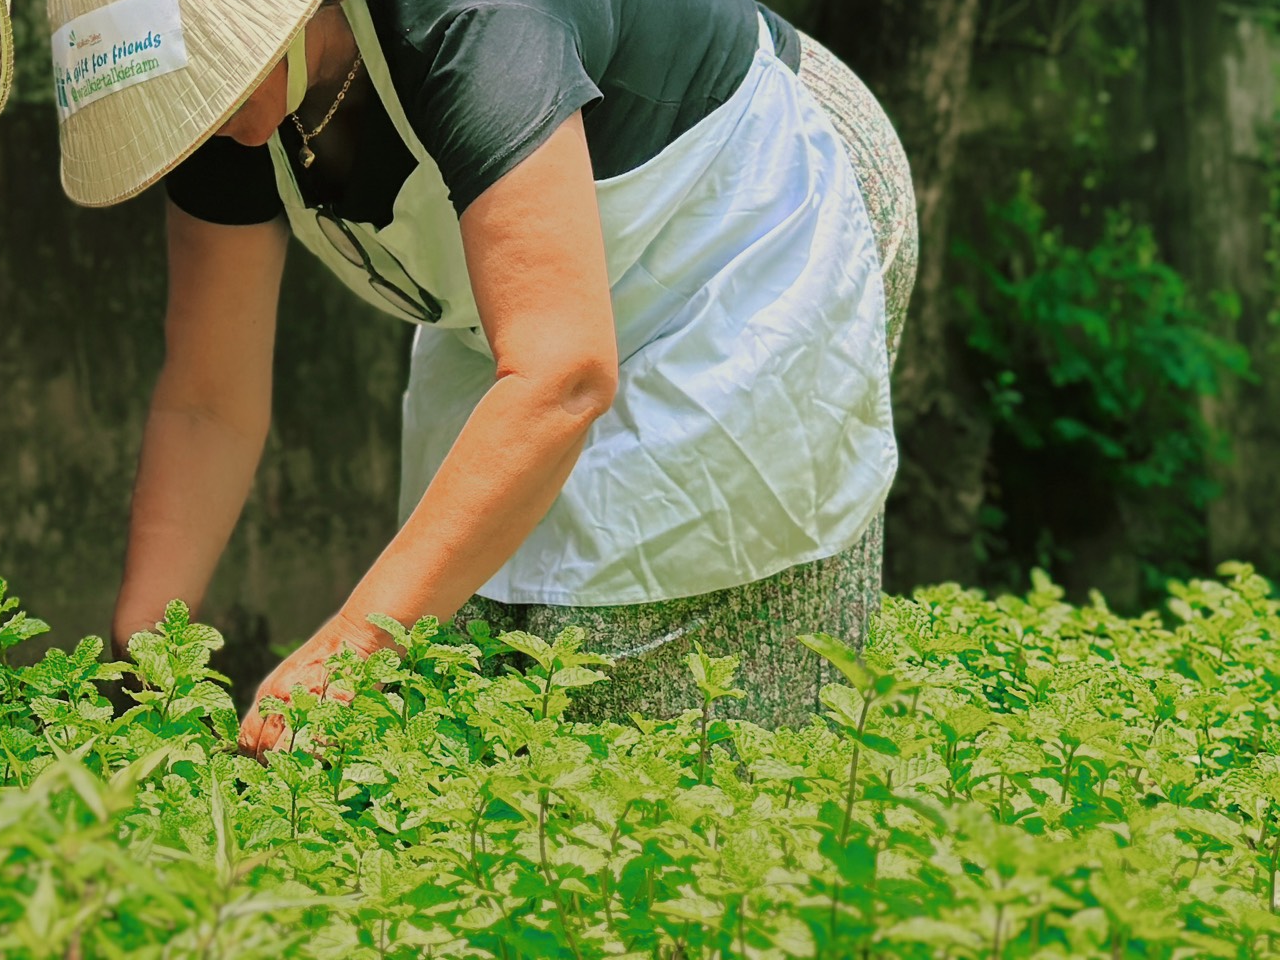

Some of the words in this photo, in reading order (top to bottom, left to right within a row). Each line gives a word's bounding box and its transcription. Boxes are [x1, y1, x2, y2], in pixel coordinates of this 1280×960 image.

[66, 69, 72, 84] A
[73, 57, 89, 82] gift
[92, 53, 108, 73] for
[112, 31, 161, 64] friends
